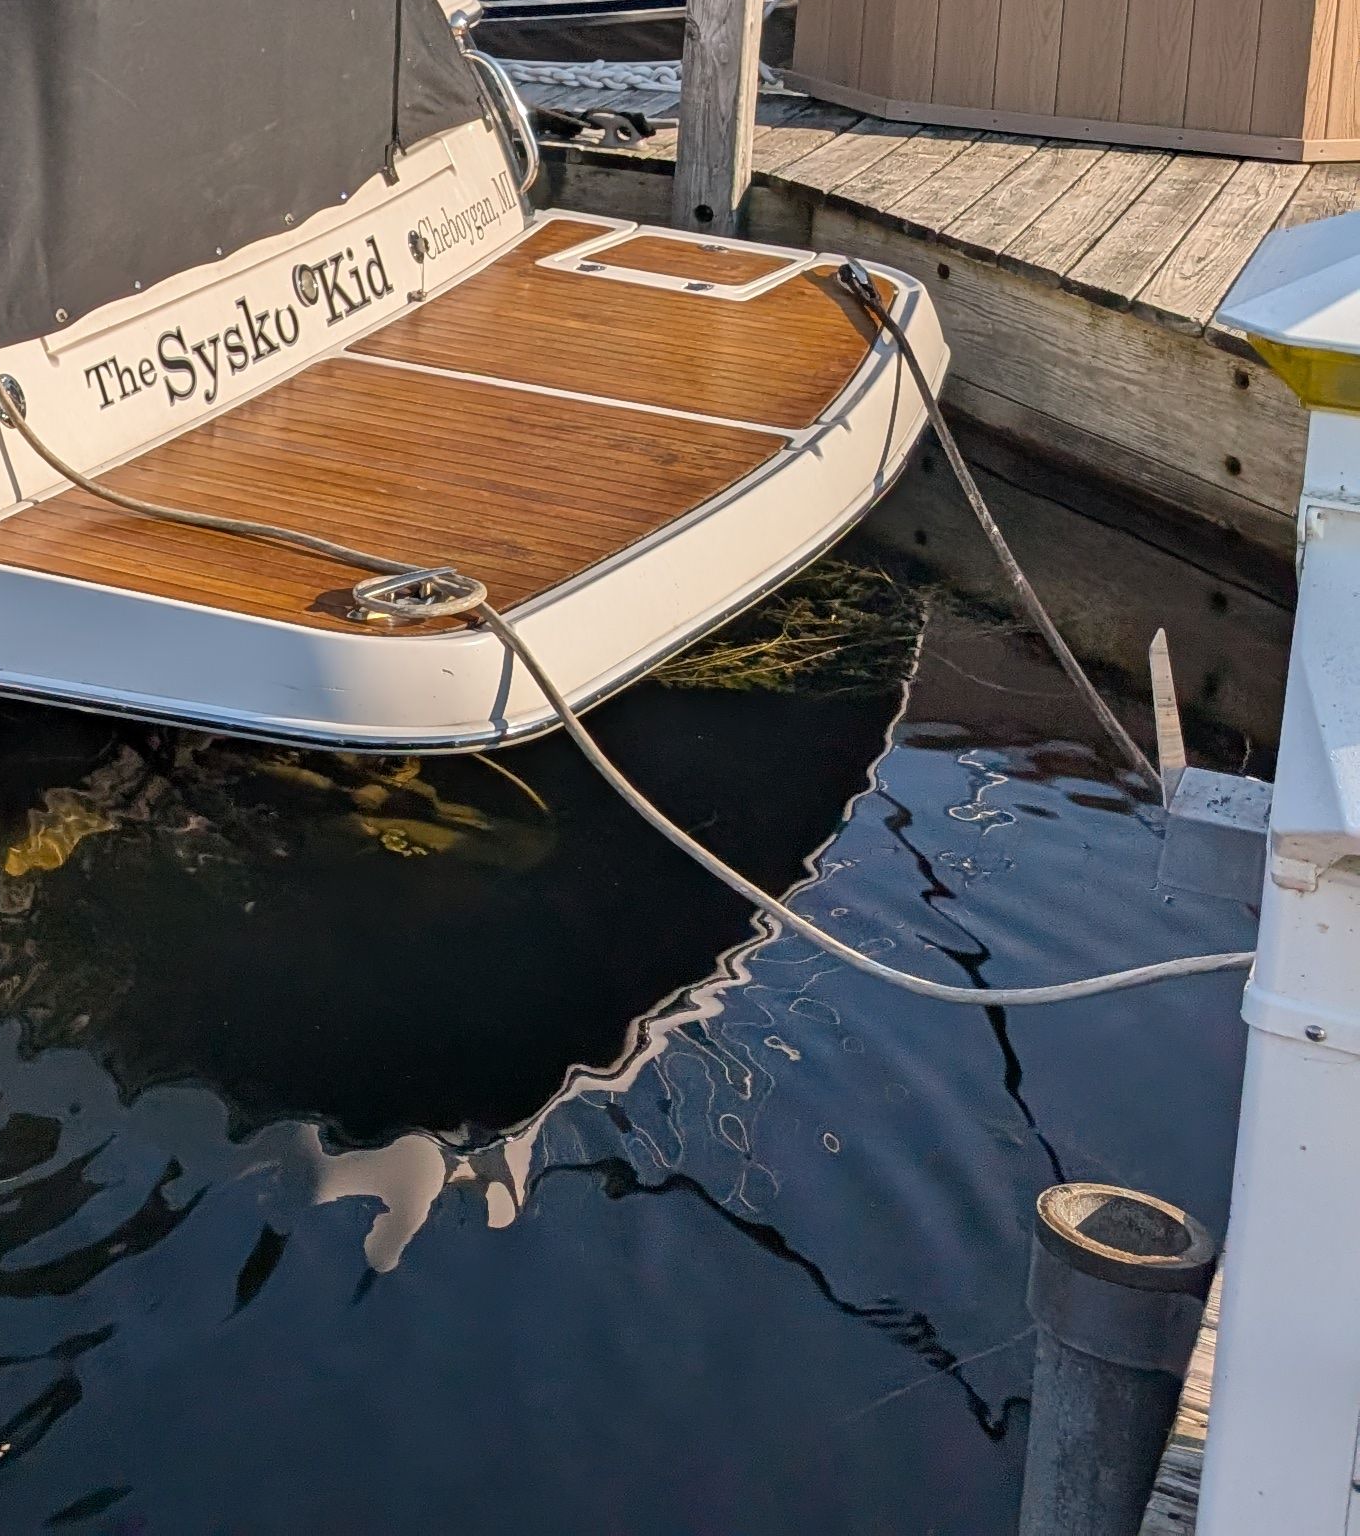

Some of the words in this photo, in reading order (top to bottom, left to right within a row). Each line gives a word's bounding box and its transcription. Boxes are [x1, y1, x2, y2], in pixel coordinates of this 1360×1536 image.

[417, 196, 501, 260] Cheboygan,
[491, 170, 517, 214] MI
[83, 354, 158, 411] The
[157, 295, 300, 408] Sysko
[312, 234, 395, 328] Kid
